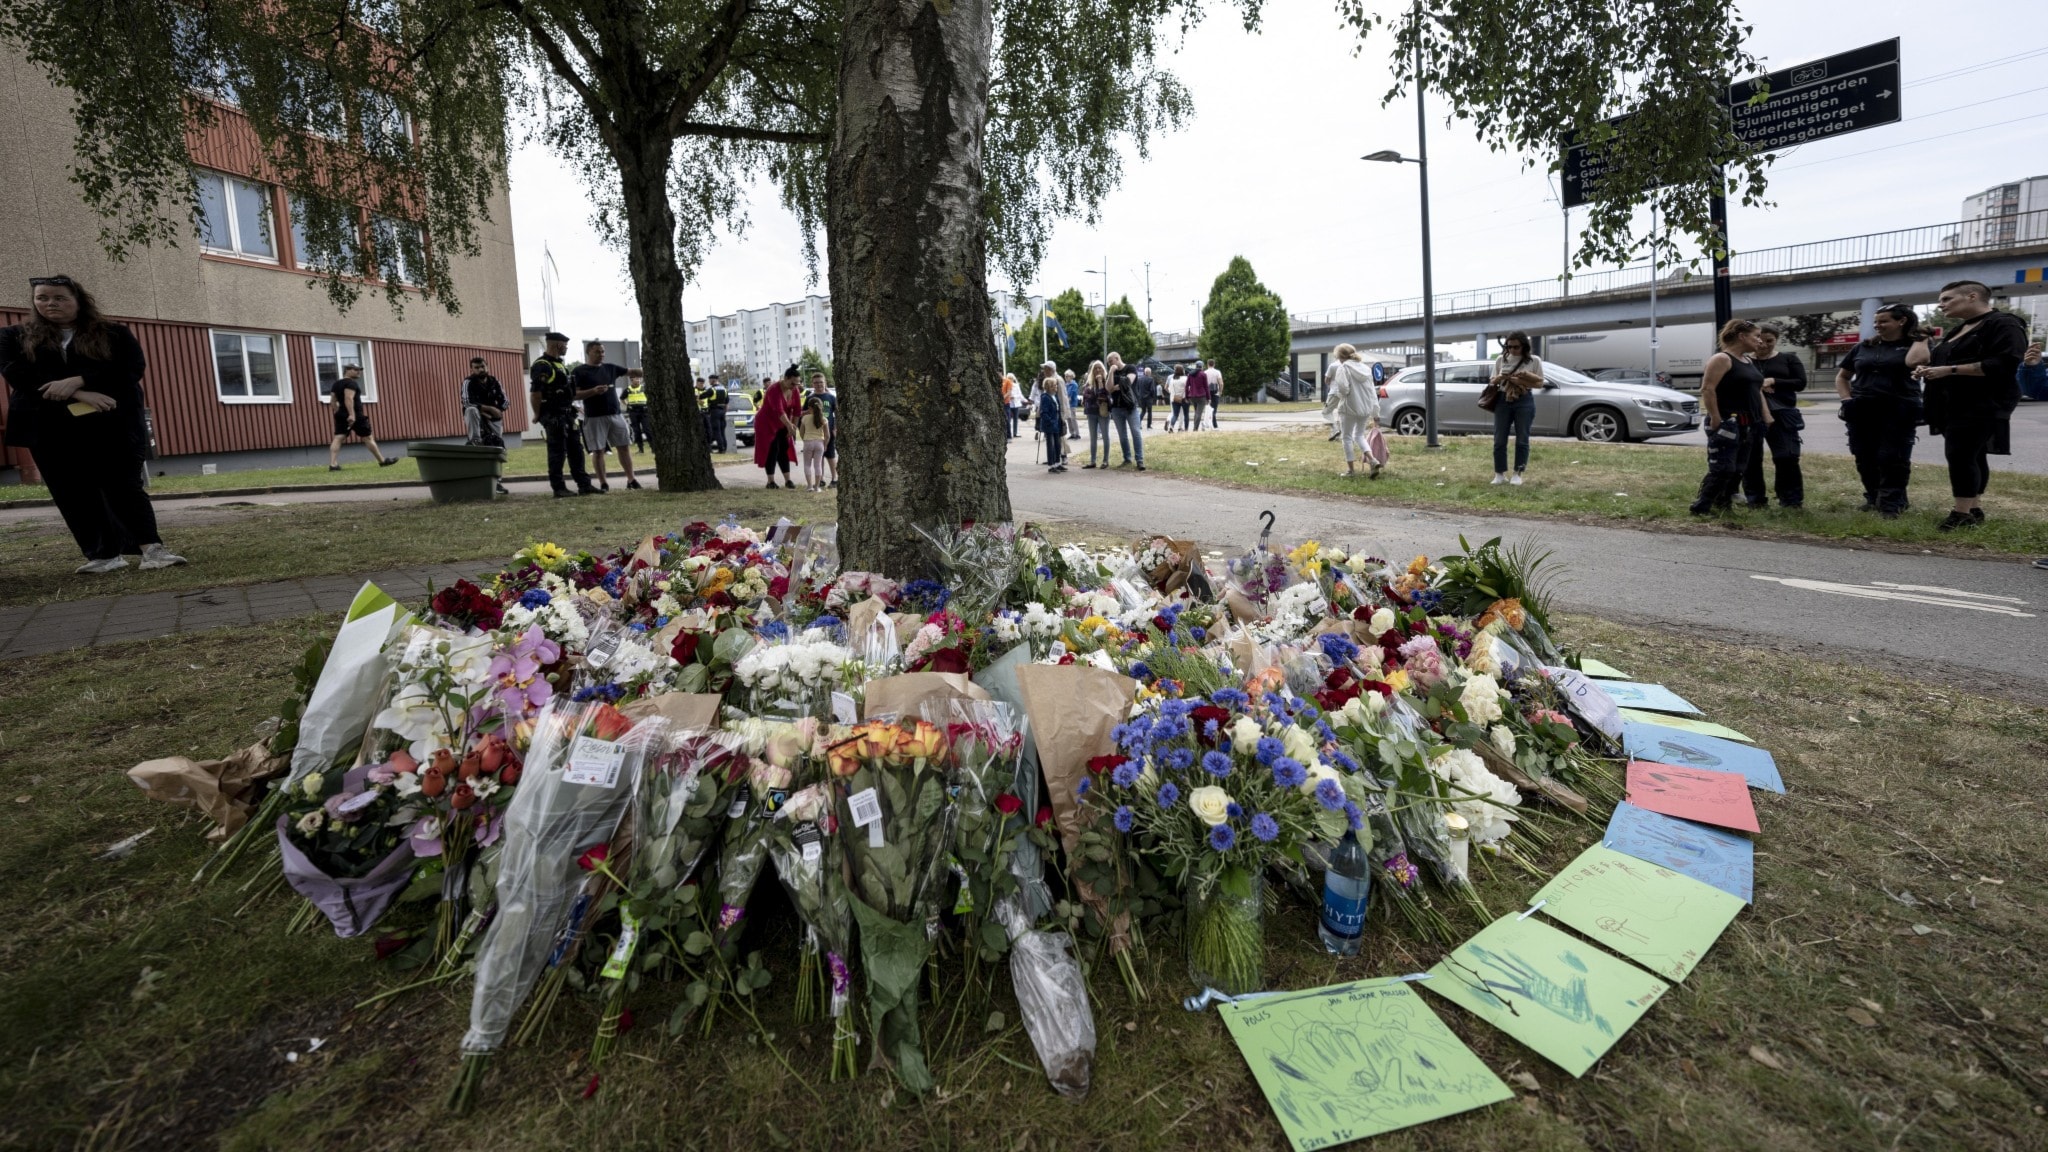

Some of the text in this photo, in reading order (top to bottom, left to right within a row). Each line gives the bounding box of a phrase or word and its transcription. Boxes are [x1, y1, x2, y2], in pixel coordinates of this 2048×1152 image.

[1736, 77, 1868, 118] Länsmansgården
[1737, 98, 1839, 129] Sjumilastigen
[1738, 102, 1865, 141] Väderlekstorget
[1242, 1010, 1271, 1027] POLIS
